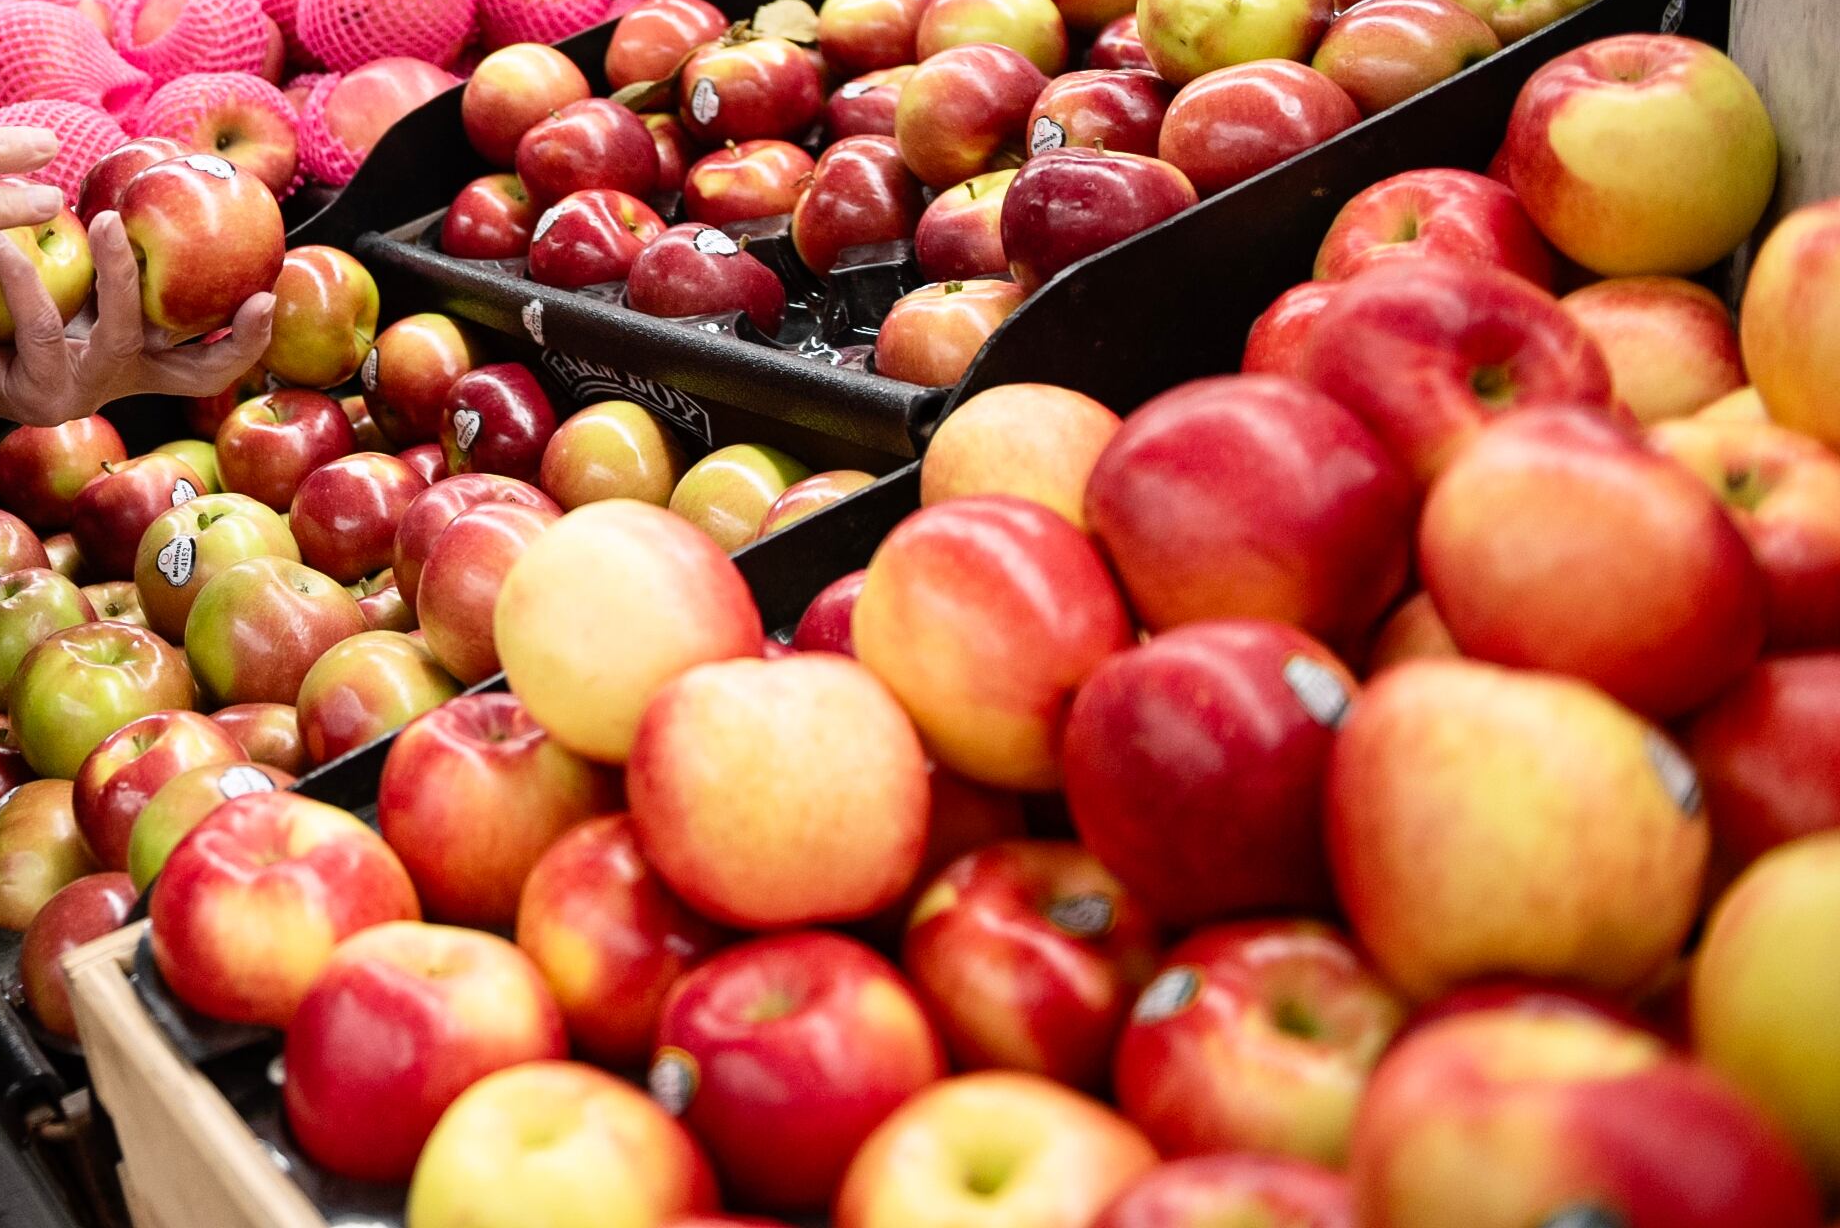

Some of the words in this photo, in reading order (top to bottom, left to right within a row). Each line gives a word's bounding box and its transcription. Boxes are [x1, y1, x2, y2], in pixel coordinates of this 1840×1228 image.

[549, 351, 623, 387] FARM
[625, 372, 700, 423] BOY
[172, 541, 184, 578] McIntosh
[180, 547, 191, 572] #4152
